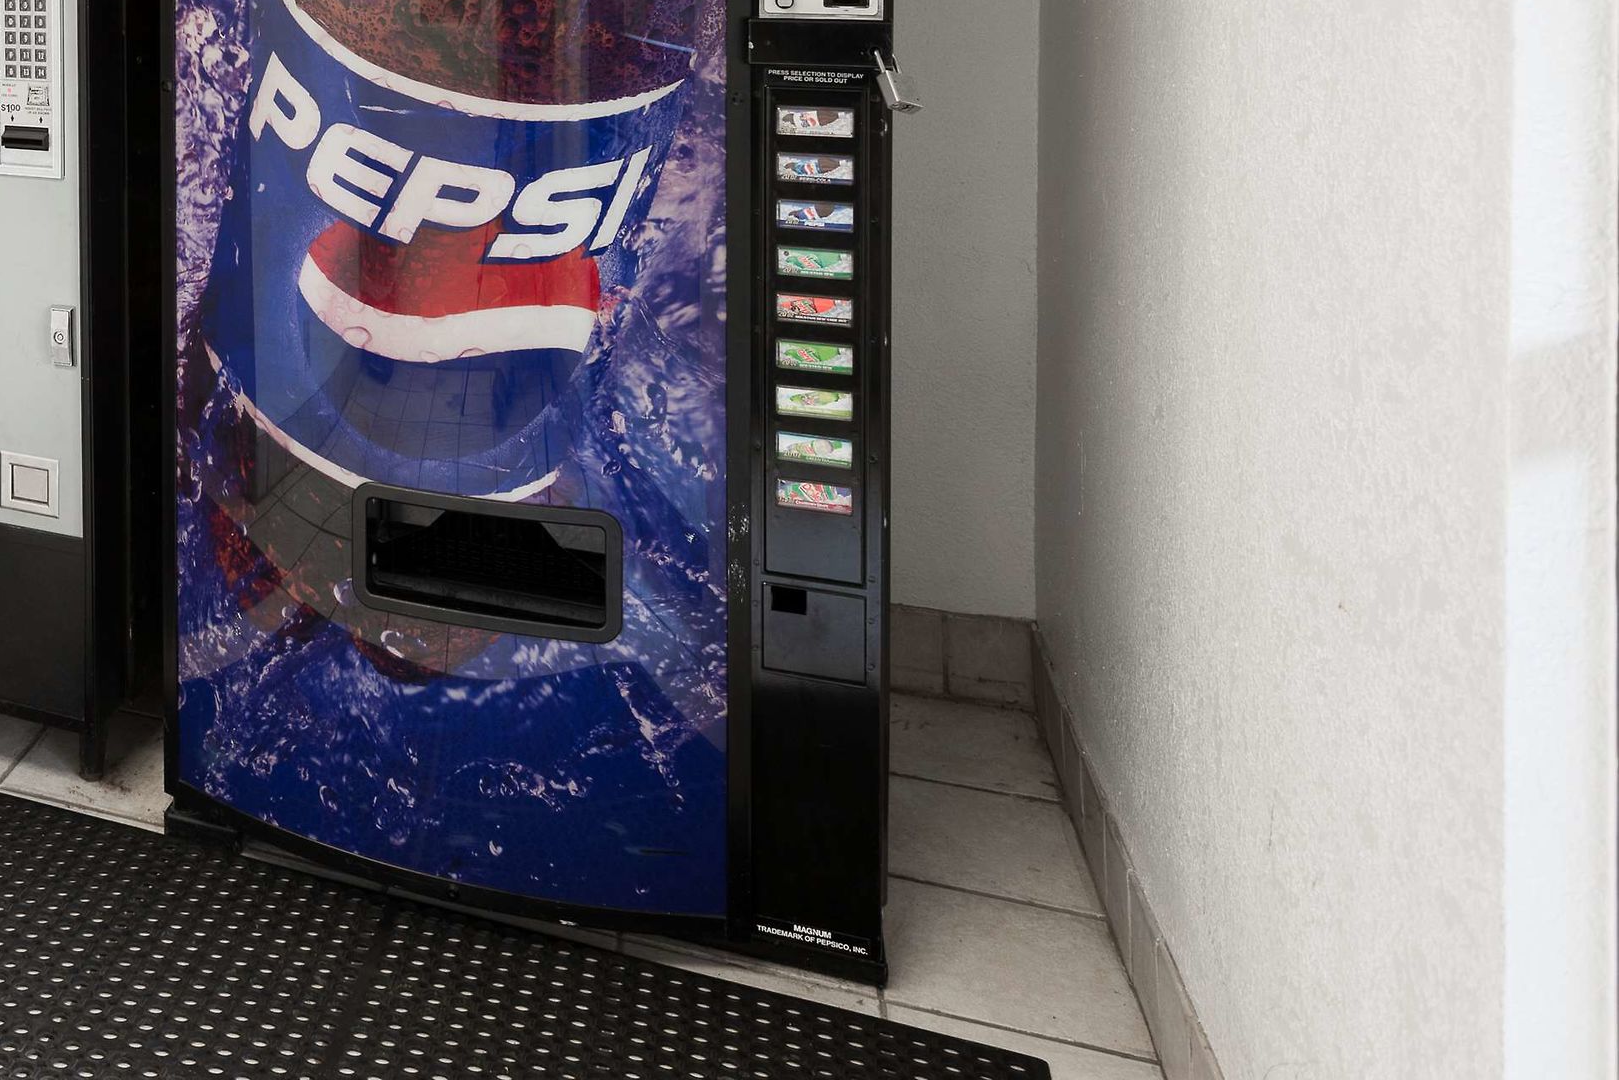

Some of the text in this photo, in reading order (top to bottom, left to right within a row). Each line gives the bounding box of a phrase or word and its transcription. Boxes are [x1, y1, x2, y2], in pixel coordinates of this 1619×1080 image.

[790, 70, 826, 78] SELECTION
[247, 50, 649, 260] PEPSI
[756, 924, 869, 955] TRADEMARK OF PEPSICO, INC.
[793, 924, 832, 939] MAGNUM
